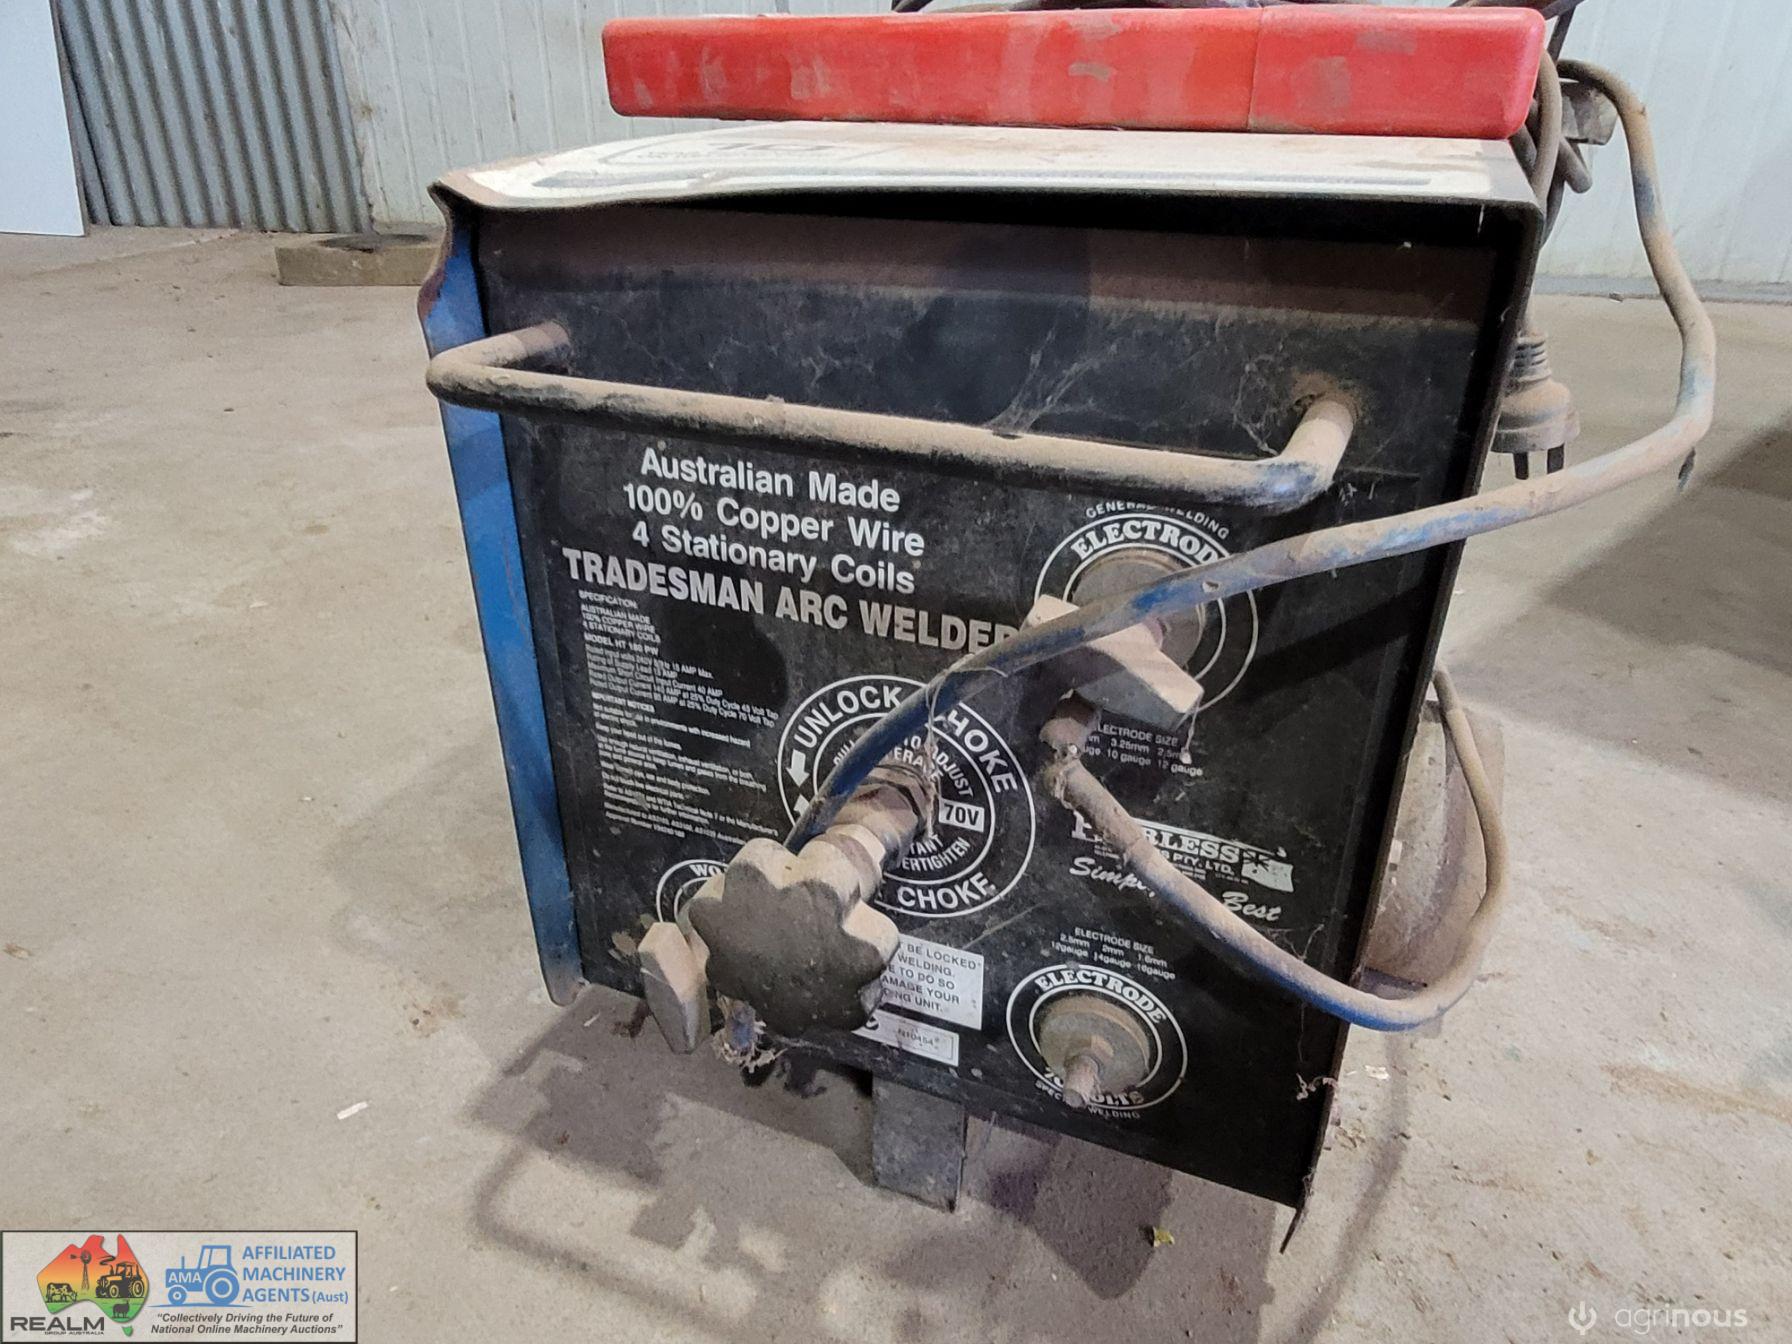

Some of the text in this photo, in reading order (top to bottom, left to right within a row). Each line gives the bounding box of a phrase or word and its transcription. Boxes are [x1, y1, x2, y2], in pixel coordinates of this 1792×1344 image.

[641, 447, 900, 513] Australian Made
[623, 484, 926, 557] 100% Copper Wire
[1071, 520, 1219, 563] ELECTROD
[632, 521, 915, 595] 4 Stationary Coils
[562, 547, 765, 616] TRADESMAN
[775, 585, 848, 631] ARC
[581, 604, 651, 625] AUSTRALIAN MADE
[601, 616, 634, 630] COPPER
[584, 632, 614, 647] MODEL
[707, 686, 723, 698] AMP
[793, 685, 903, 750] UNLOCK
[1095, 722, 1179, 747] LECTRODE SIZE
[1107, 748, 1119, 760] 10
[1120, 753, 1152, 767] gauge
[1170, 763, 1204, 778] gauge
[943, 803, 980, 826] 70V
[901, 836, 972, 873] ERTIGHTEN
[1173, 853, 1203, 868] PTY.
[896, 871, 993, 911] CHOKE
[1221, 890, 1282, 922] Best
[1074, 926, 1154, 955] ELECTRODE SIZE
[1102, 944, 1125, 957] 2mm
[907, 943, 977, 971] BE LOCKED
[881, 974, 923, 994] AMAGE
[926, 986, 961, 1005] YOUR
[900, 965, 914, 979] TO
[918, 971, 935, 984] DO
[938, 977, 955, 990] SO
[1034, 969, 1167, 1024] ELECTRODE
